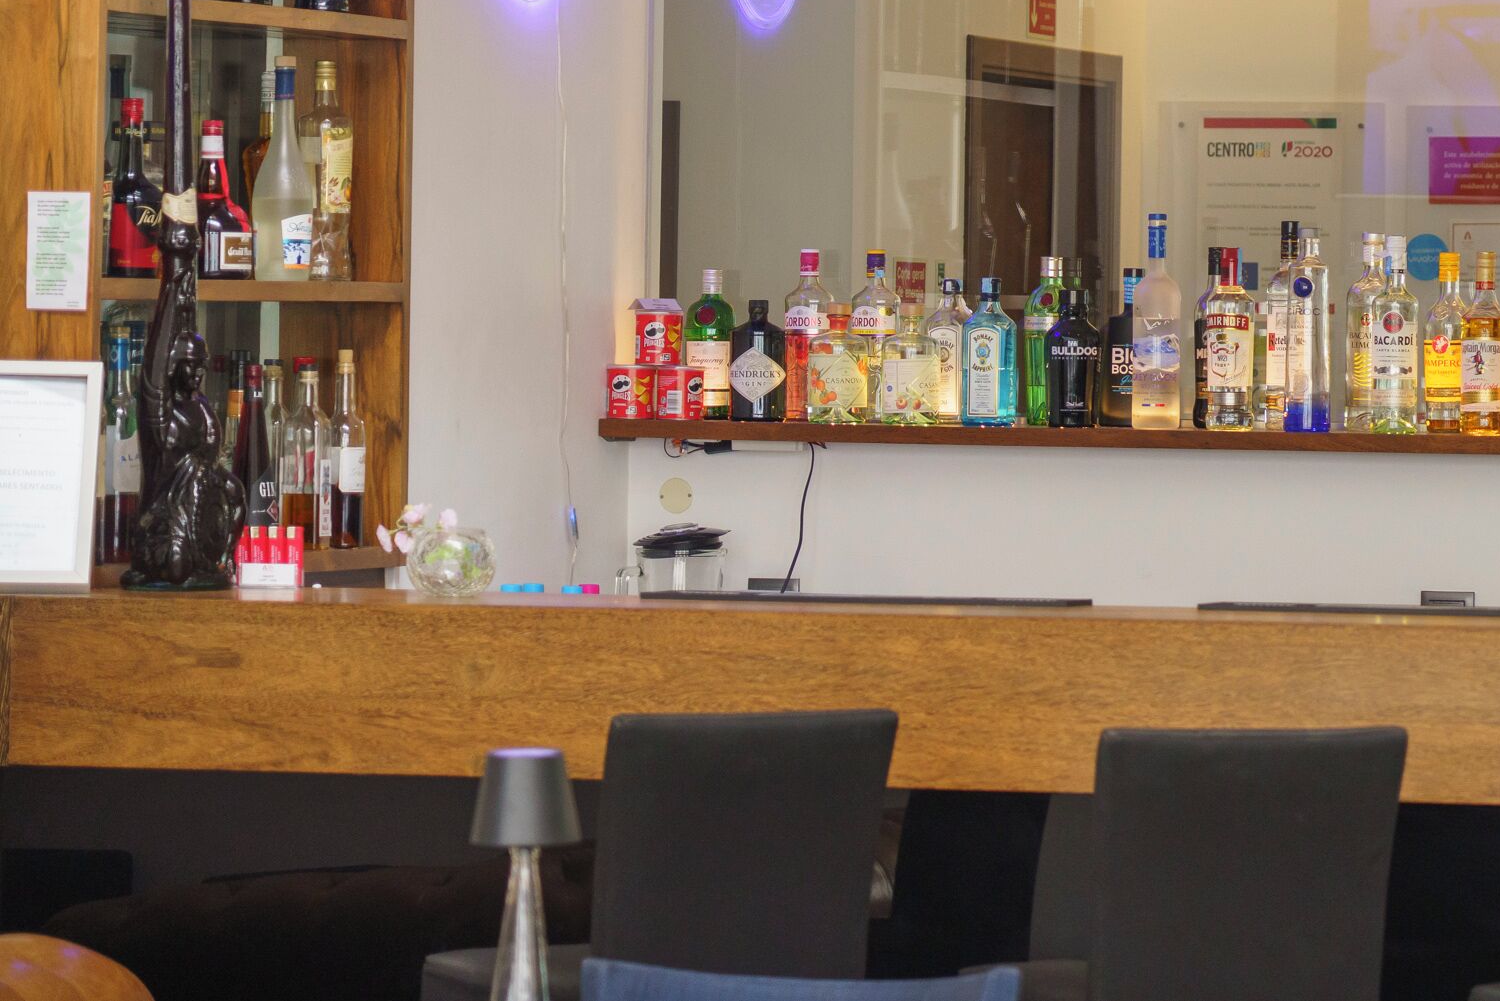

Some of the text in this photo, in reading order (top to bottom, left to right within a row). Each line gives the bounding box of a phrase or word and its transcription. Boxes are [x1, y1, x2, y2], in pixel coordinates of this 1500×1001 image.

[1206, 142, 1255, 158] CENTRO
[1294, 145, 1333, 158] 2020
[973, 333, 993, 343] BOMBAY
[1373, 333, 1413, 346] BACARDÍ
[1051, 346, 1098, 356] BULLDOG
[689, 355, 724, 365] Tanqueray
[730, 370, 781, 379] HENDRICK'S
[825, 377, 863, 385] CASANOVA
